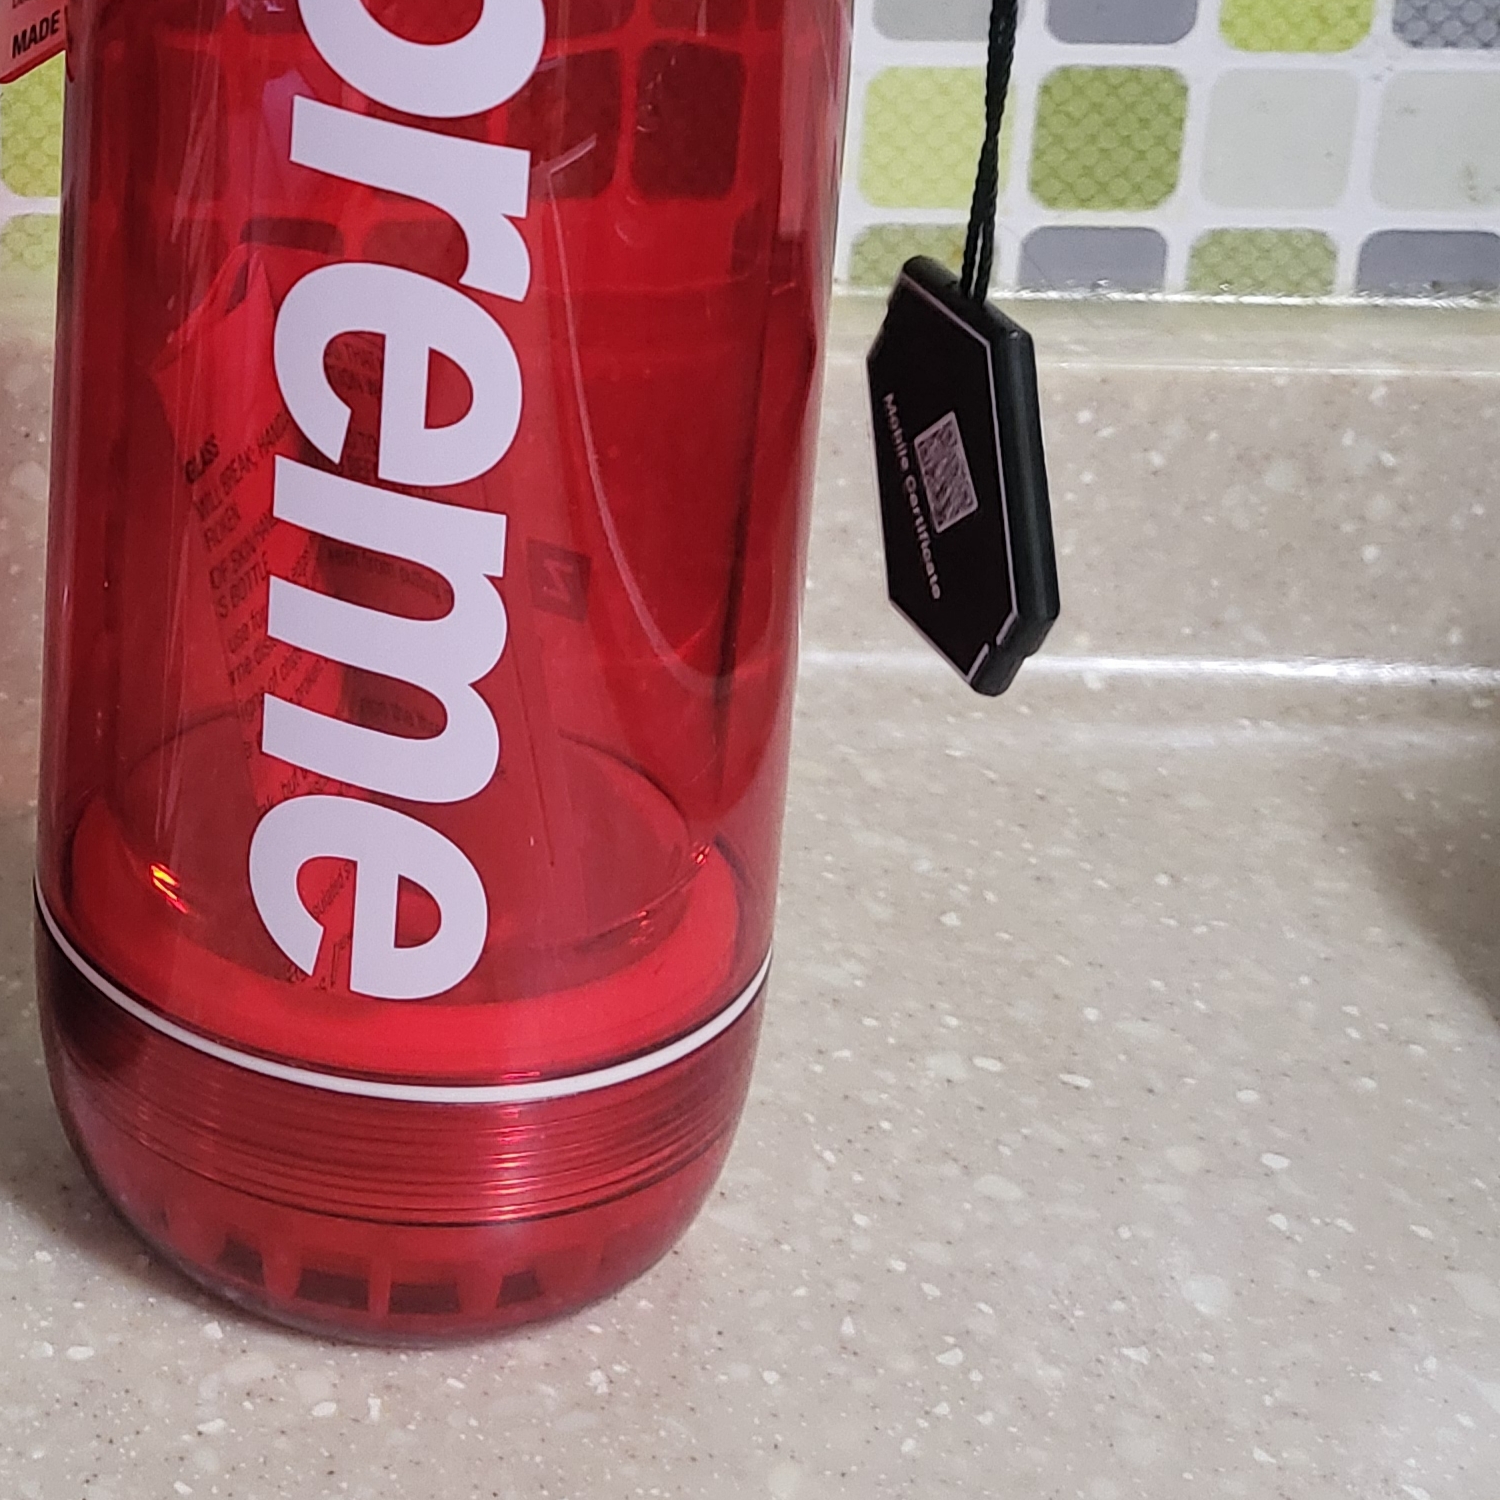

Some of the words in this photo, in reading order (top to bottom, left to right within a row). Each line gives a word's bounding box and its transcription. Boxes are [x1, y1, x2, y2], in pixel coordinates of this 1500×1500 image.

[11, 8, 61, 60] MADE
[883, 392, 910, 473] Mobile
[905, 473, 942, 600] Certificate
